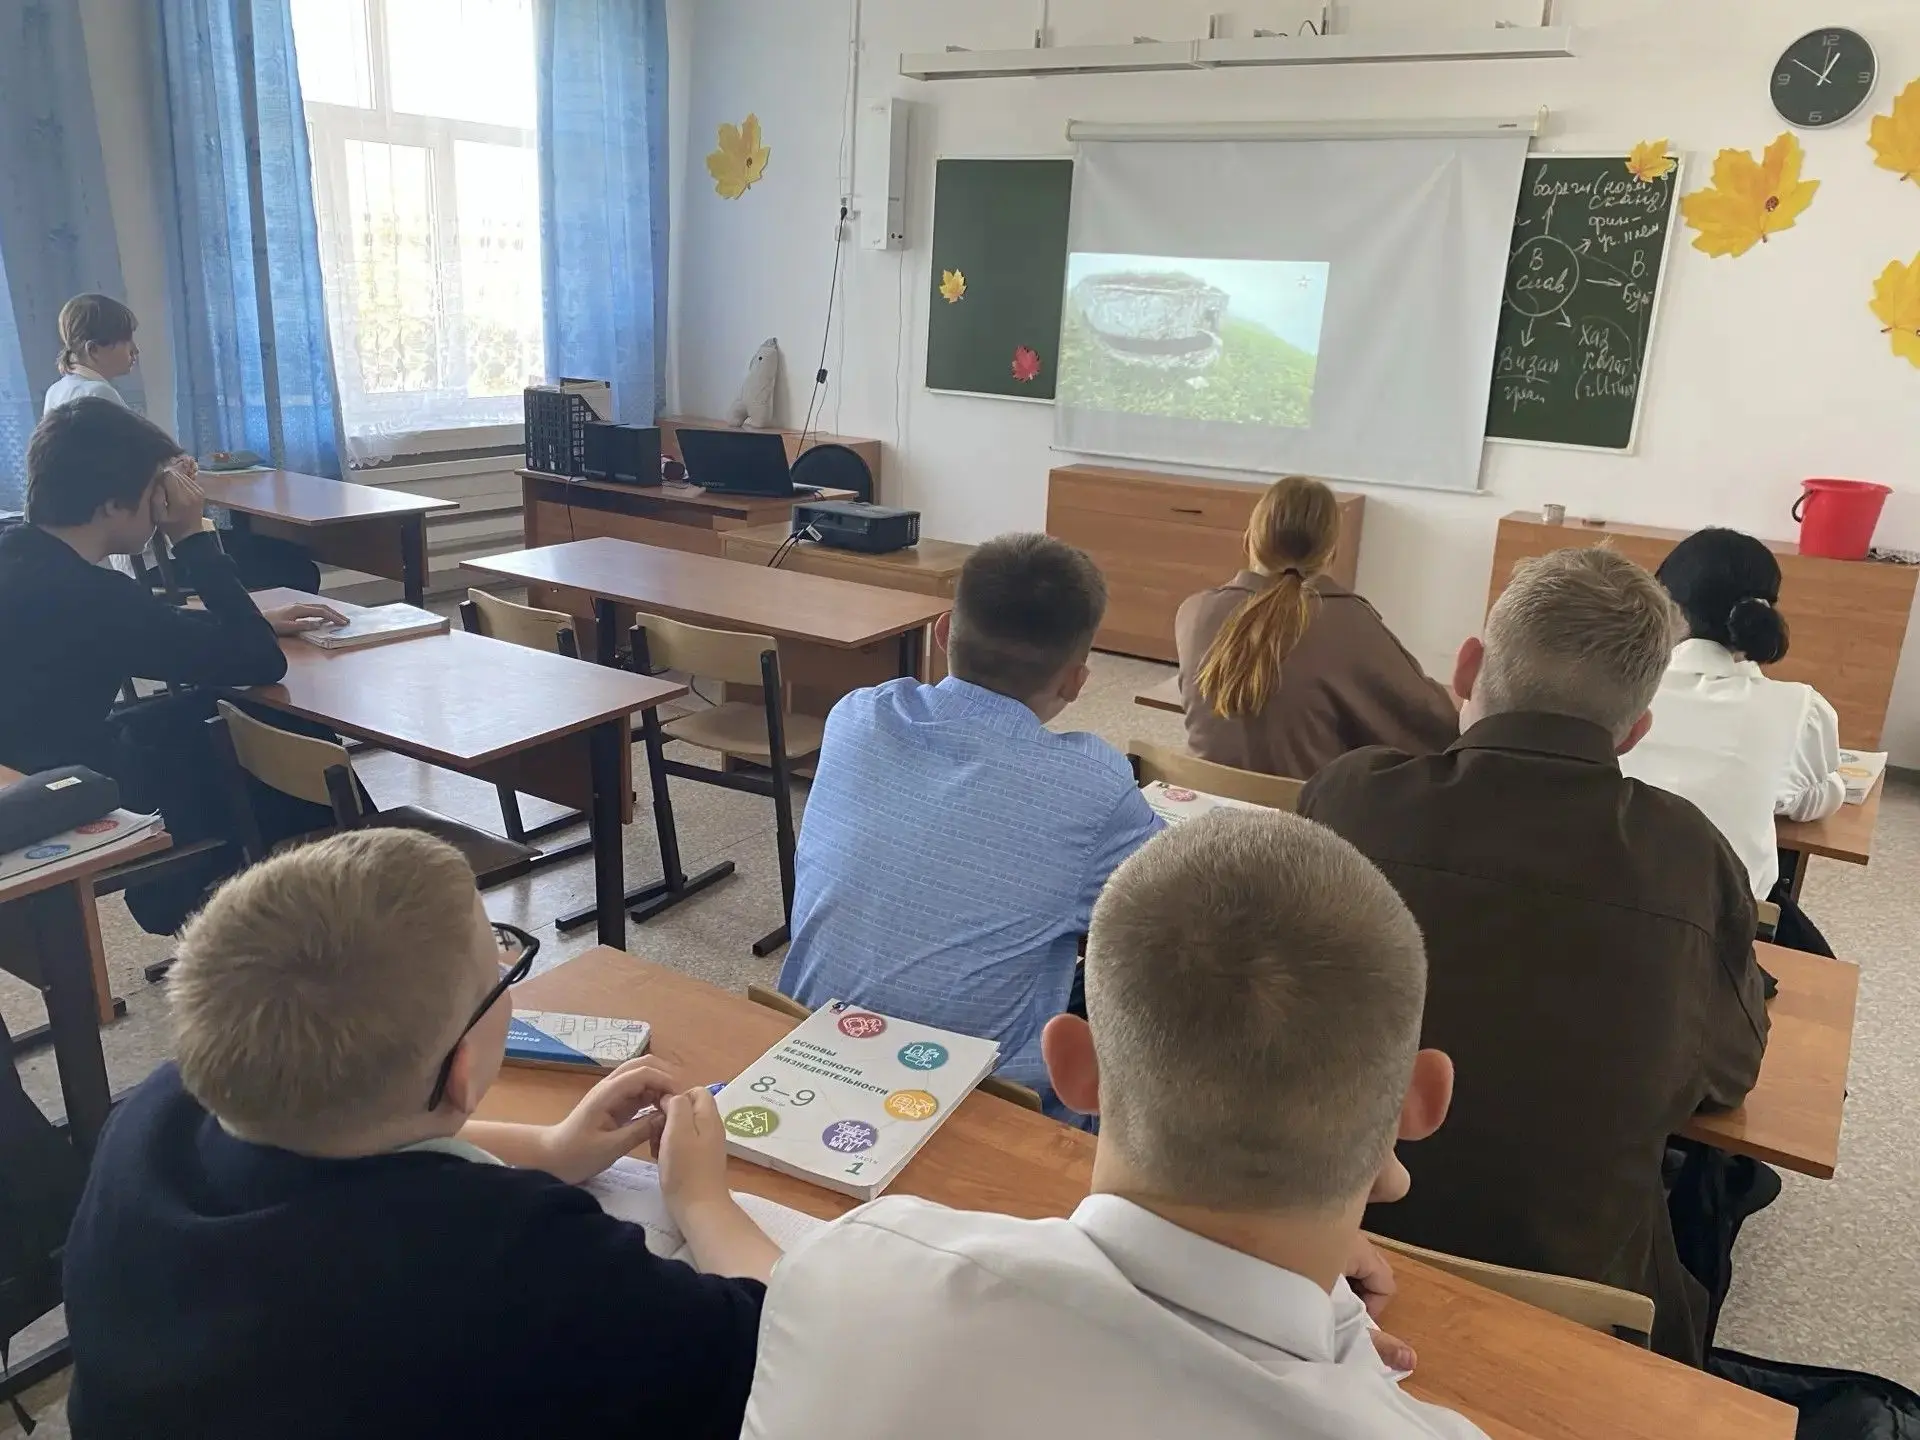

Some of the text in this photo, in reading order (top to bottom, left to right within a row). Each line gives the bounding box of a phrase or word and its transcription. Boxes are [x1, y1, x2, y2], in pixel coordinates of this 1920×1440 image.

[1822, 34, 1840, 47] 12
[1777, 73, 1791, 86] 9
[1857, 71, 1871, 84] 3
[1808, 110, 1823, 123] 6
[793, 1039, 837, 1057] ОСНОВЫ
[784, 1047, 863, 1076] БЕЗОПАСНОСТИ
[773, 1054, 889, 1095] ЖИЗНЕДЕЯТЕЛЬНОСТИ
[845, 1162, 864, 1175] 1
